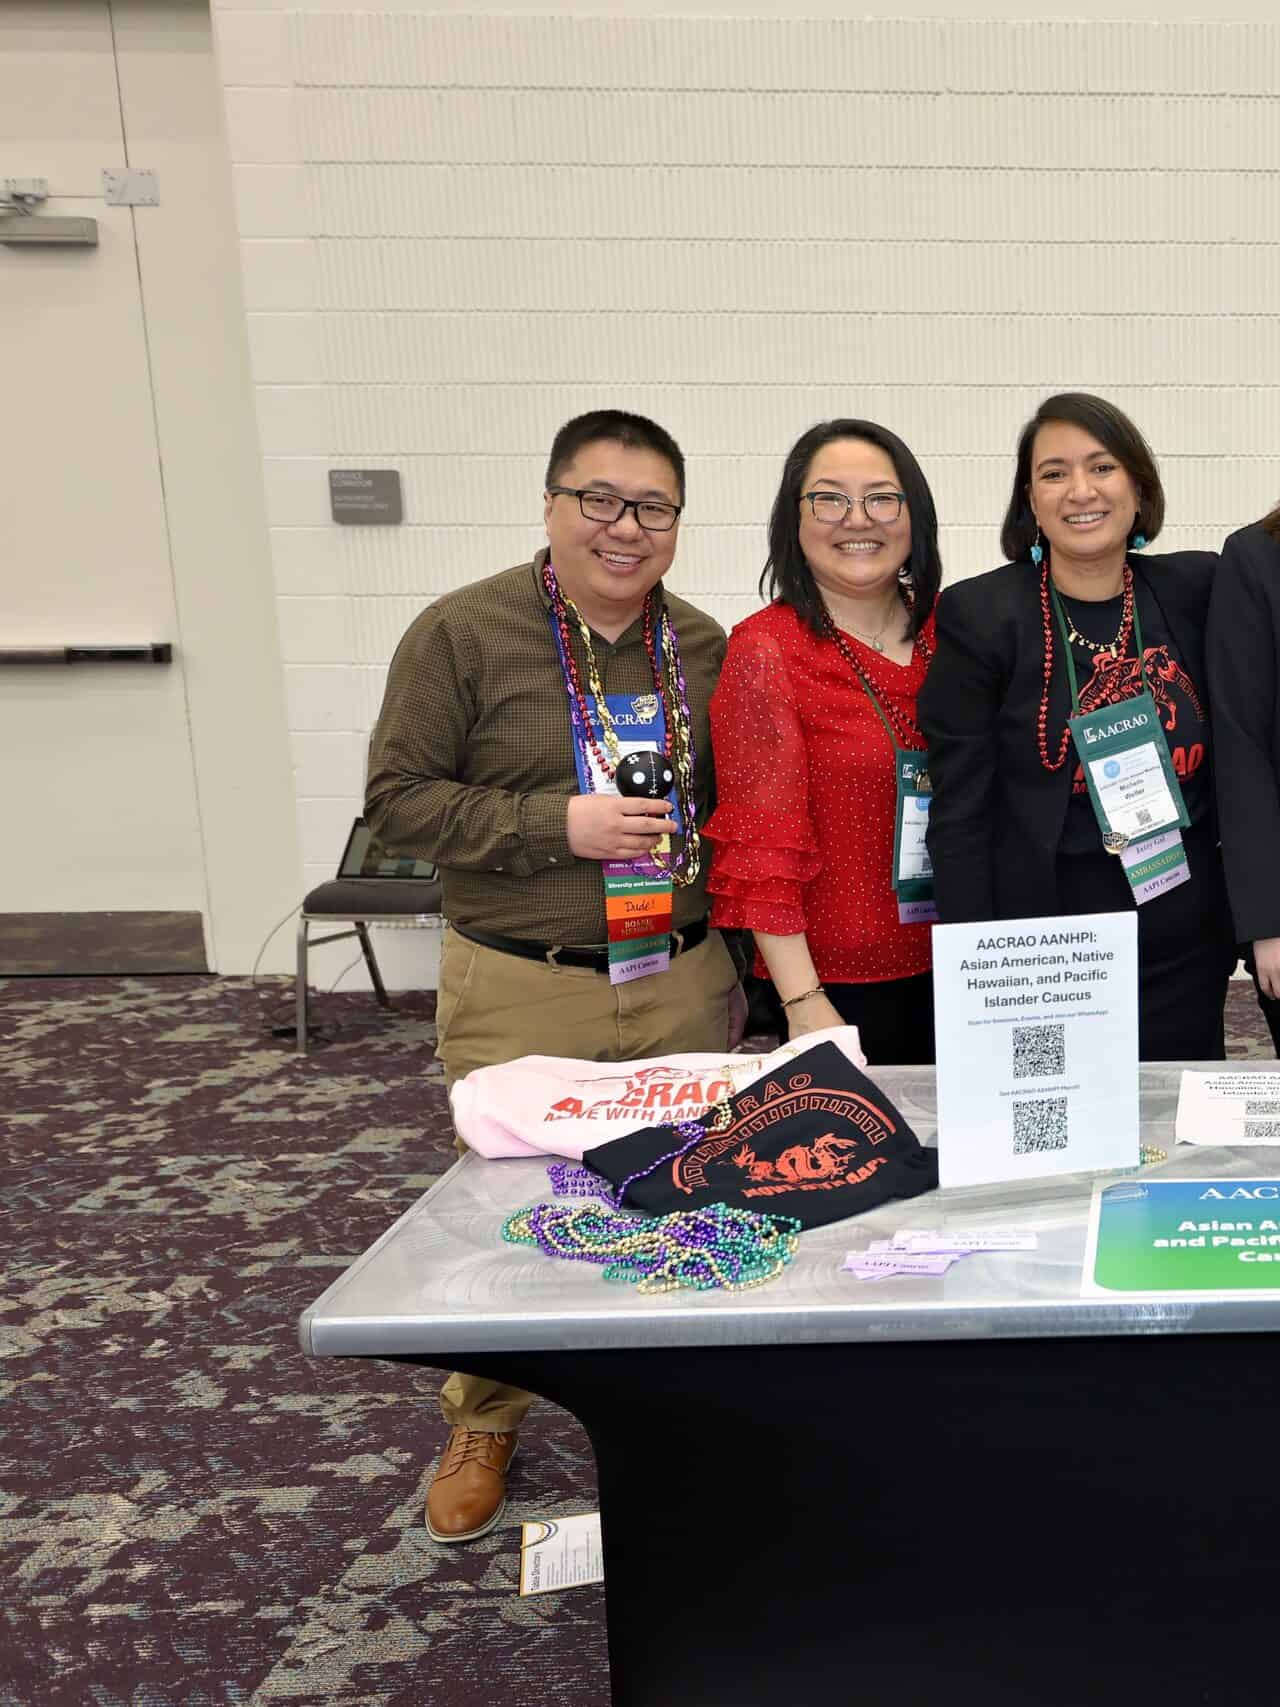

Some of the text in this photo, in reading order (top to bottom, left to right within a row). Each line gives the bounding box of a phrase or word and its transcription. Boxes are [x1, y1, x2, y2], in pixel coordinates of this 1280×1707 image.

[1097, 713, 1149, 740] AACRAO
[976, 931, 1097, 951] AACRAO AANHPI:
[960, 949, 1114, 972] Asian American, Native
[967, 968, 1108, 991] Hawaiian, and Pacific
[984, 989, 1092, 1008] Islander Caucus
[606, 1107, 655, 1121] WITH
[1178, 1219, 1249, 1232] Asian
[1153, 1233, 1206, 1248] and
